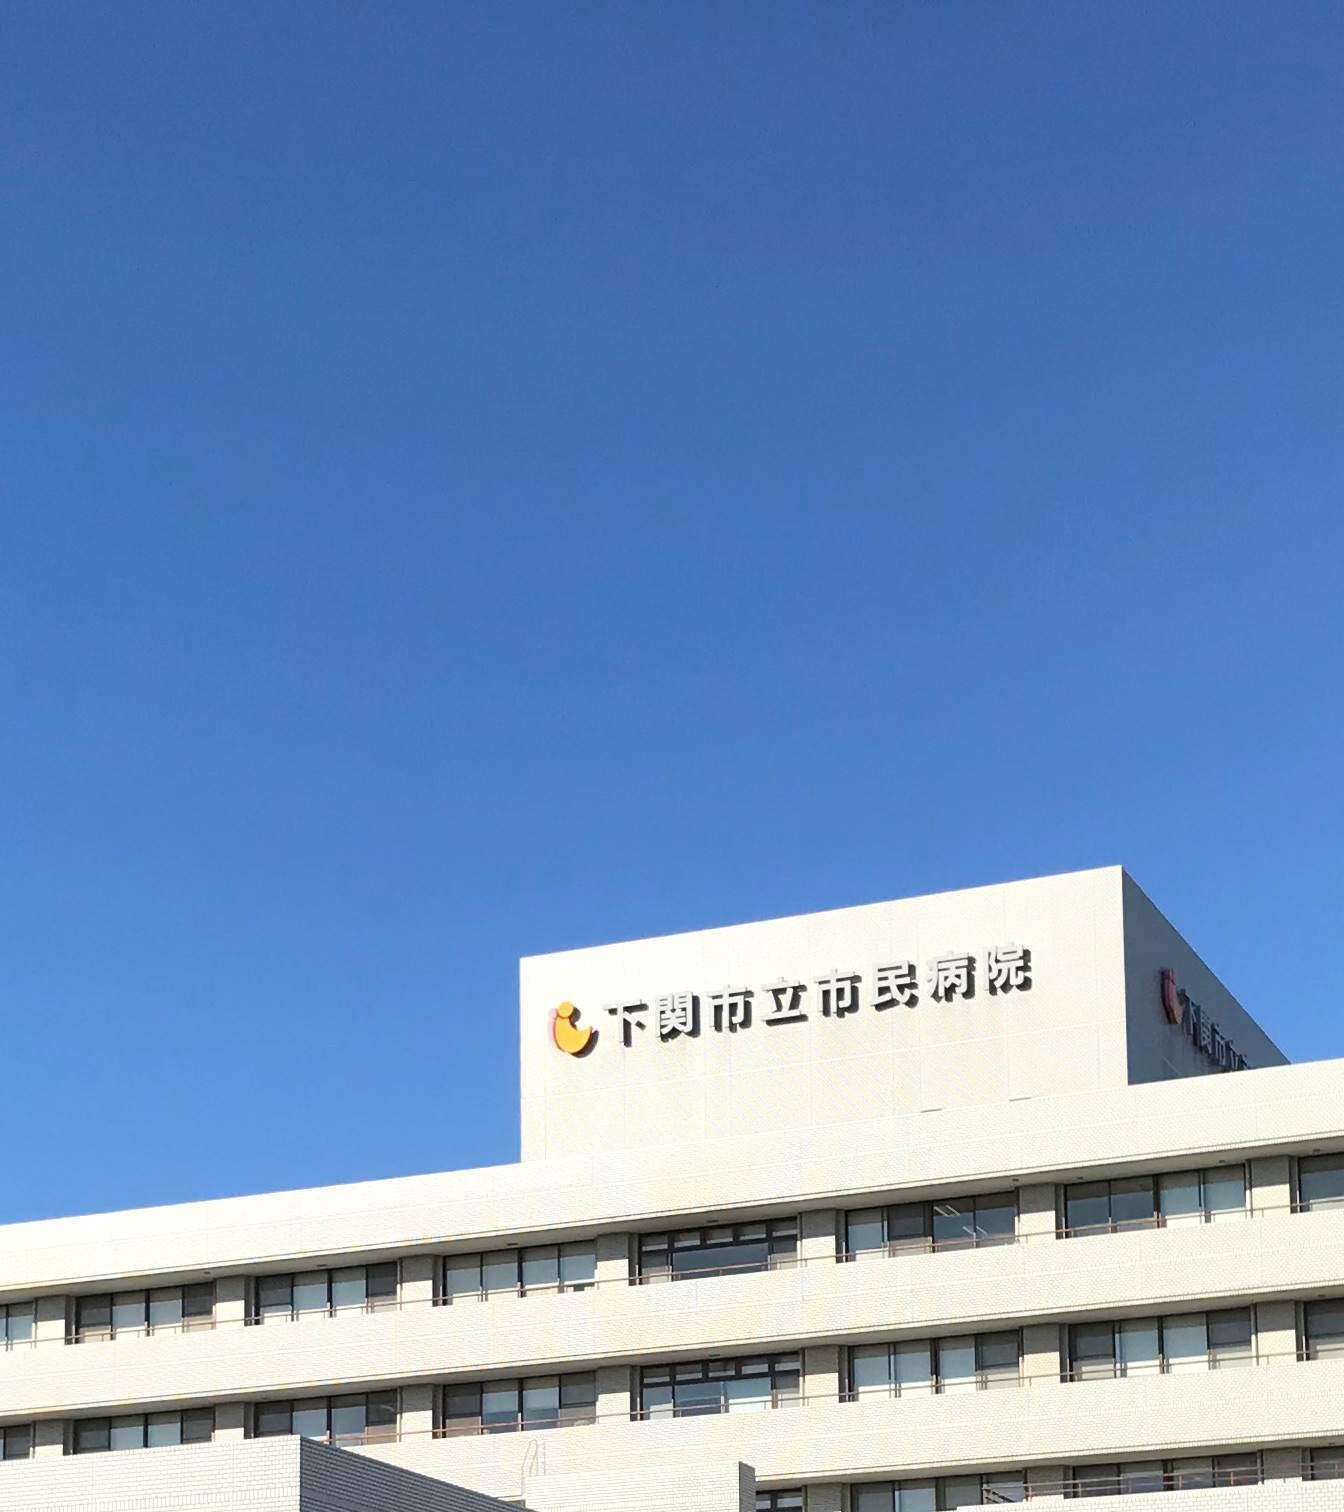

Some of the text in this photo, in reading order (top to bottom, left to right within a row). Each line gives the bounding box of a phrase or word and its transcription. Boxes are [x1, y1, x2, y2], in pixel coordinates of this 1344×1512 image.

[602, 941, 1032, 1046] 下関市立市民病院
